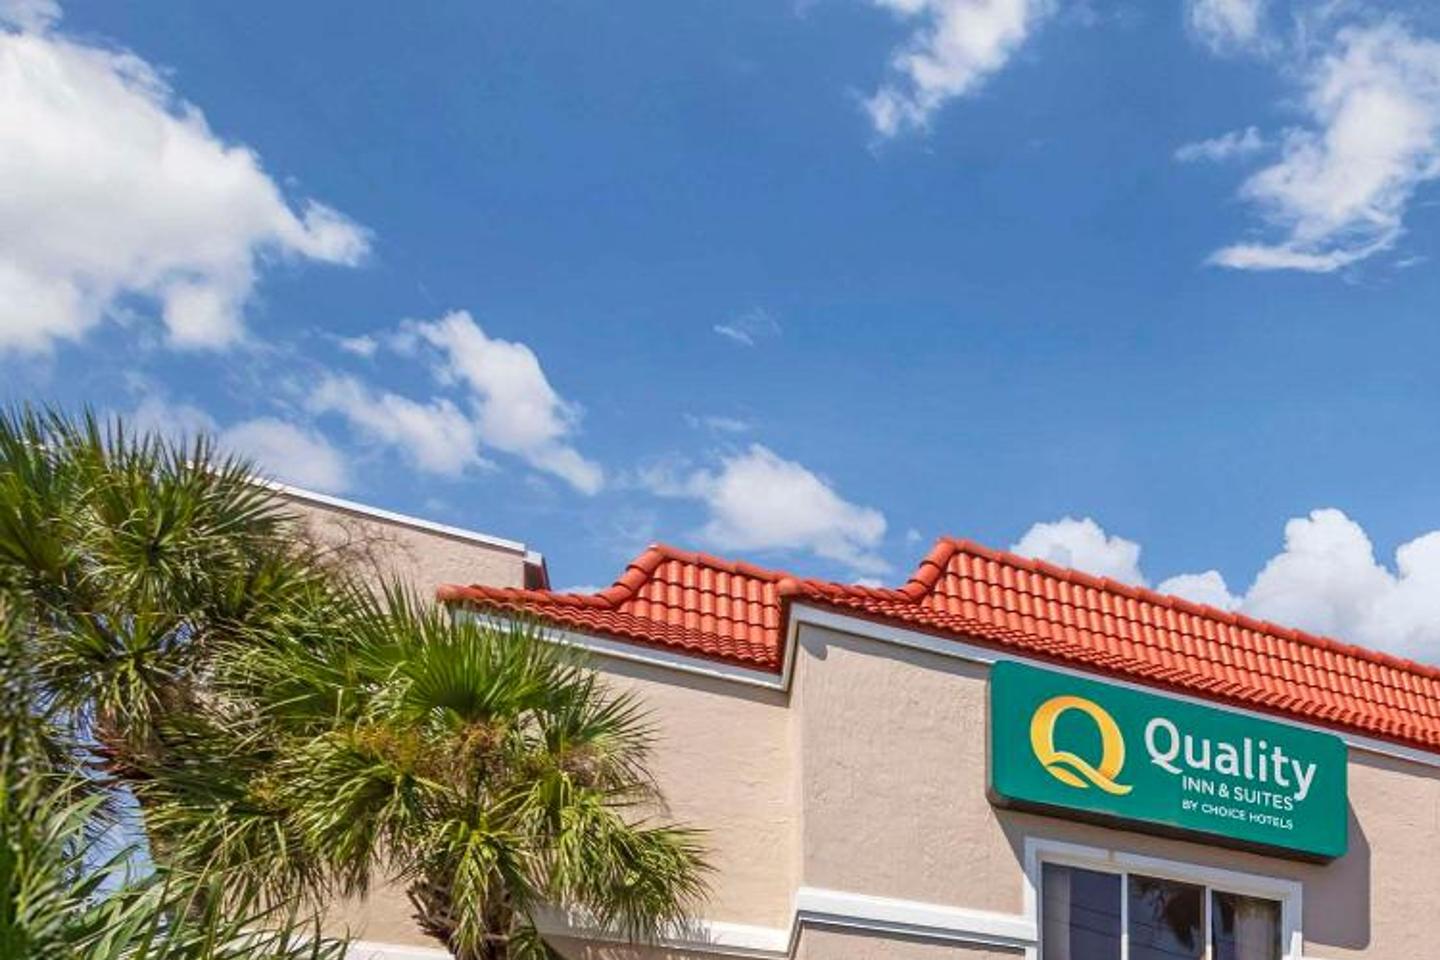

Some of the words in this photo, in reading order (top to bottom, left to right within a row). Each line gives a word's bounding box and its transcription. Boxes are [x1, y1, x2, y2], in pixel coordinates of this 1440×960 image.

[1030, 695, 1133, 795] Q
[1144, 717, 1317, 801] Quality
[1182, 775, 1215, 796] INN
[1218, 782, 1230, 800] &
[1233, 786, 1294, 812] SUITES
[1182, 799, 1199, 811] BY
[1201, 803, 1248, 821] CHOICE
[1249, 812, 1294, 831] HOTELS
